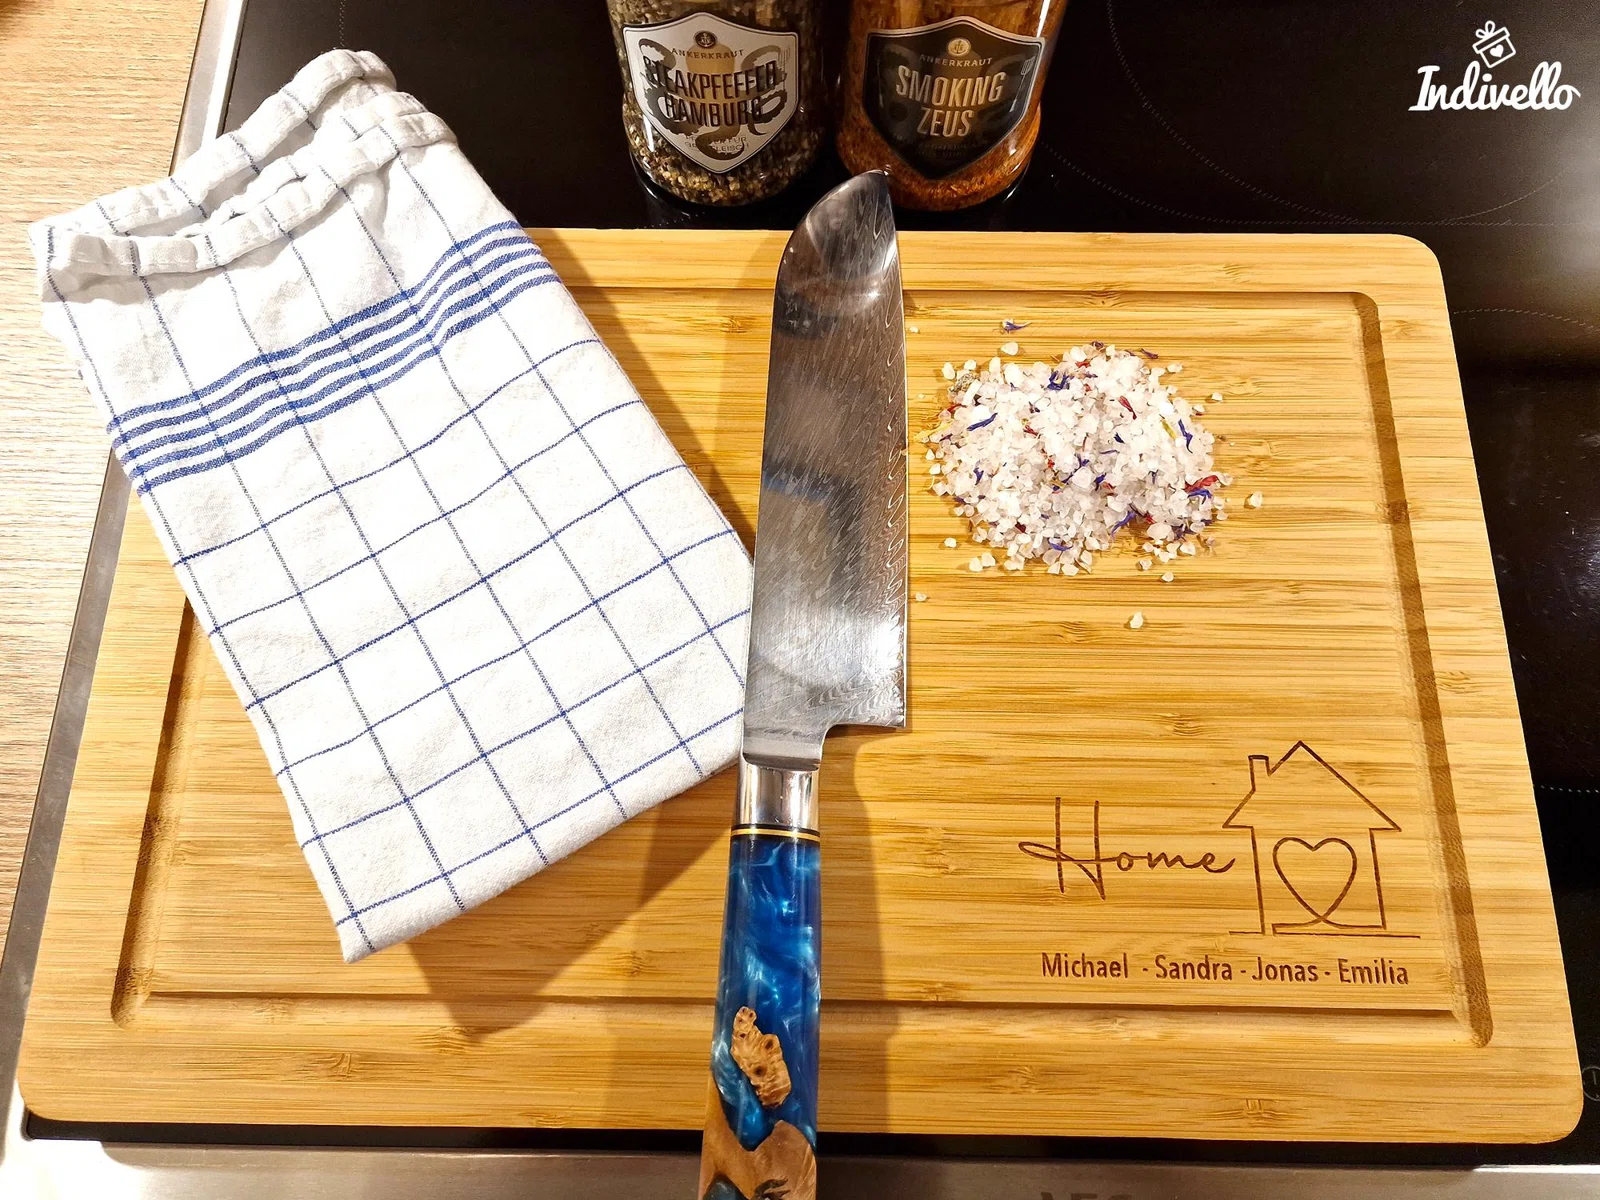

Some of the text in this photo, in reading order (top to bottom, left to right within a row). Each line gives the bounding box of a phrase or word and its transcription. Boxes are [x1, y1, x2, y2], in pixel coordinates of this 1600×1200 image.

[671, 47, 744, 60] ANKERKRAUT
[919, 54, 993, 68] ANKERKRAUT
[895, 65, 1007, 108] SMOKING
[664, 92, 762, 128] HAMBURG
[917, 107, 975, 138] ZEUS
[1018, 797, 1236, 901] Home
[1041, 952, 1129, 979] Michael
[1155, 954, 1233, 980] Sandra
[1251, 956, 1319, 982] Jonas
[1337, 958, 1409, 984] Emilia
